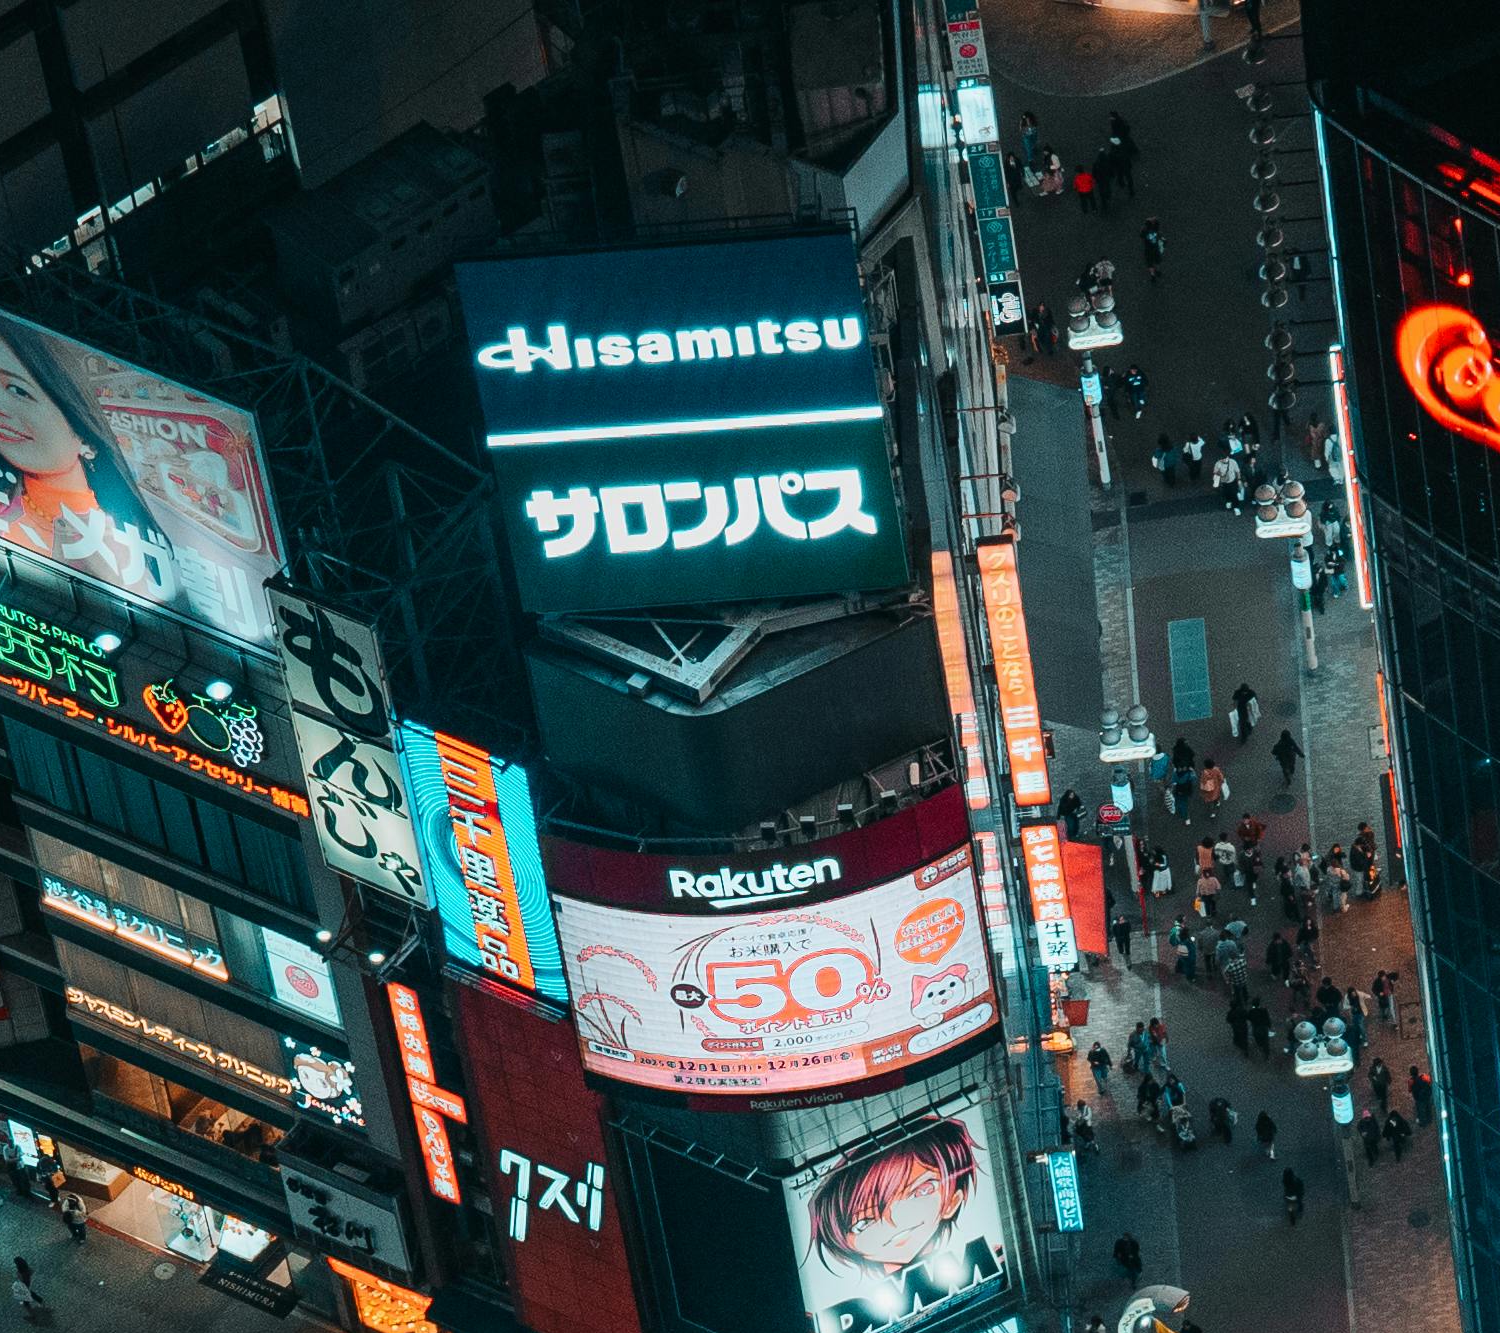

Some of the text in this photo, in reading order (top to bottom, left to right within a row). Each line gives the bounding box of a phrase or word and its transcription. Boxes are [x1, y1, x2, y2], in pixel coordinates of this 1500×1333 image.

[478, 313, 863, 374] Hisamitsu
[525, 467, 878, 559] サロンパス
[1005, 704, 1049, 796] 三千里
[440, 754, 522, 980] 三千里薬品
[668, 856, 842, 908] Rakuten
[727, 937, 813, 960] お米購入で
[932, 1008, 989, 1043] ハチペイ
[748, 1089, 845, 1112] Rakuten Vision
[1052, 1152, 1083, 1230] 大盛堂商事ビル
[216, 1276, 277, 1309] NISHIMURA
